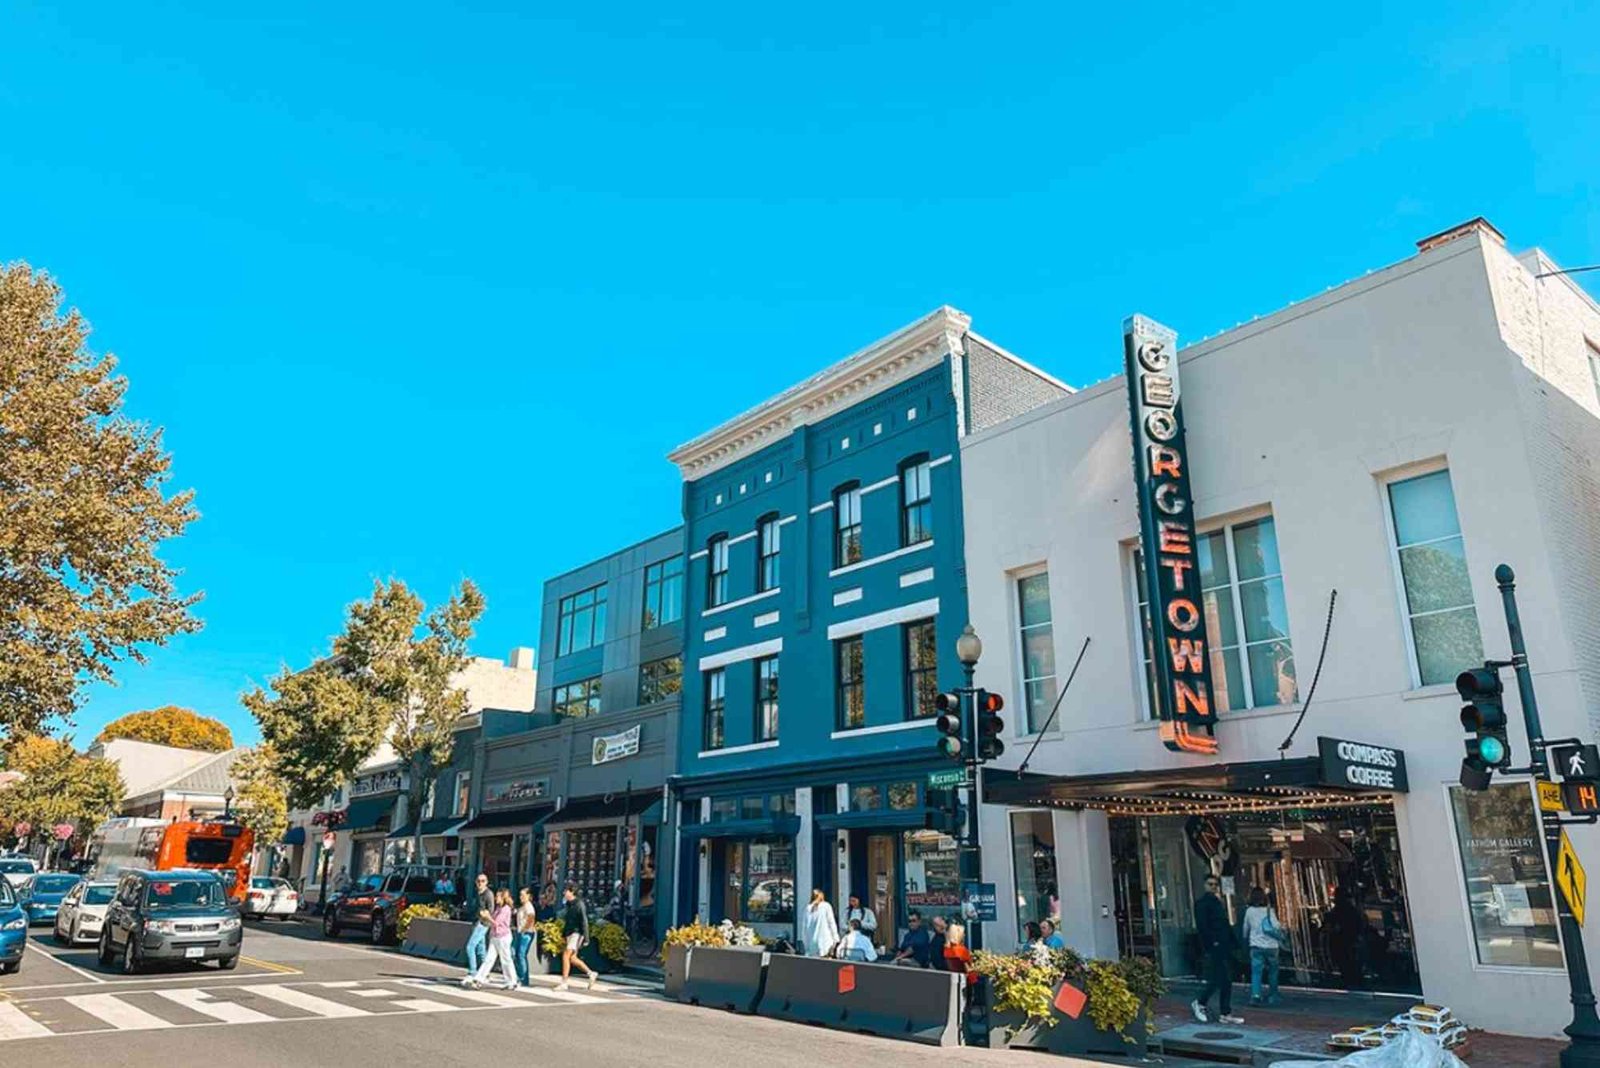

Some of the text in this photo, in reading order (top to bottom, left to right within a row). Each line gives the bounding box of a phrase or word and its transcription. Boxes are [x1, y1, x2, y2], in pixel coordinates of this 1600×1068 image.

[1138, 338, 1210, 716] GEORGETOWN
[1337, 741, 1397, 768] COMPASS
[1346, 765, 1394, 788] COFFEE
[1543, 789, 1561, 802] AHE
[1578, 785, 1598, 809] 14
[1498, 837, 1534, 848] GALLERY
